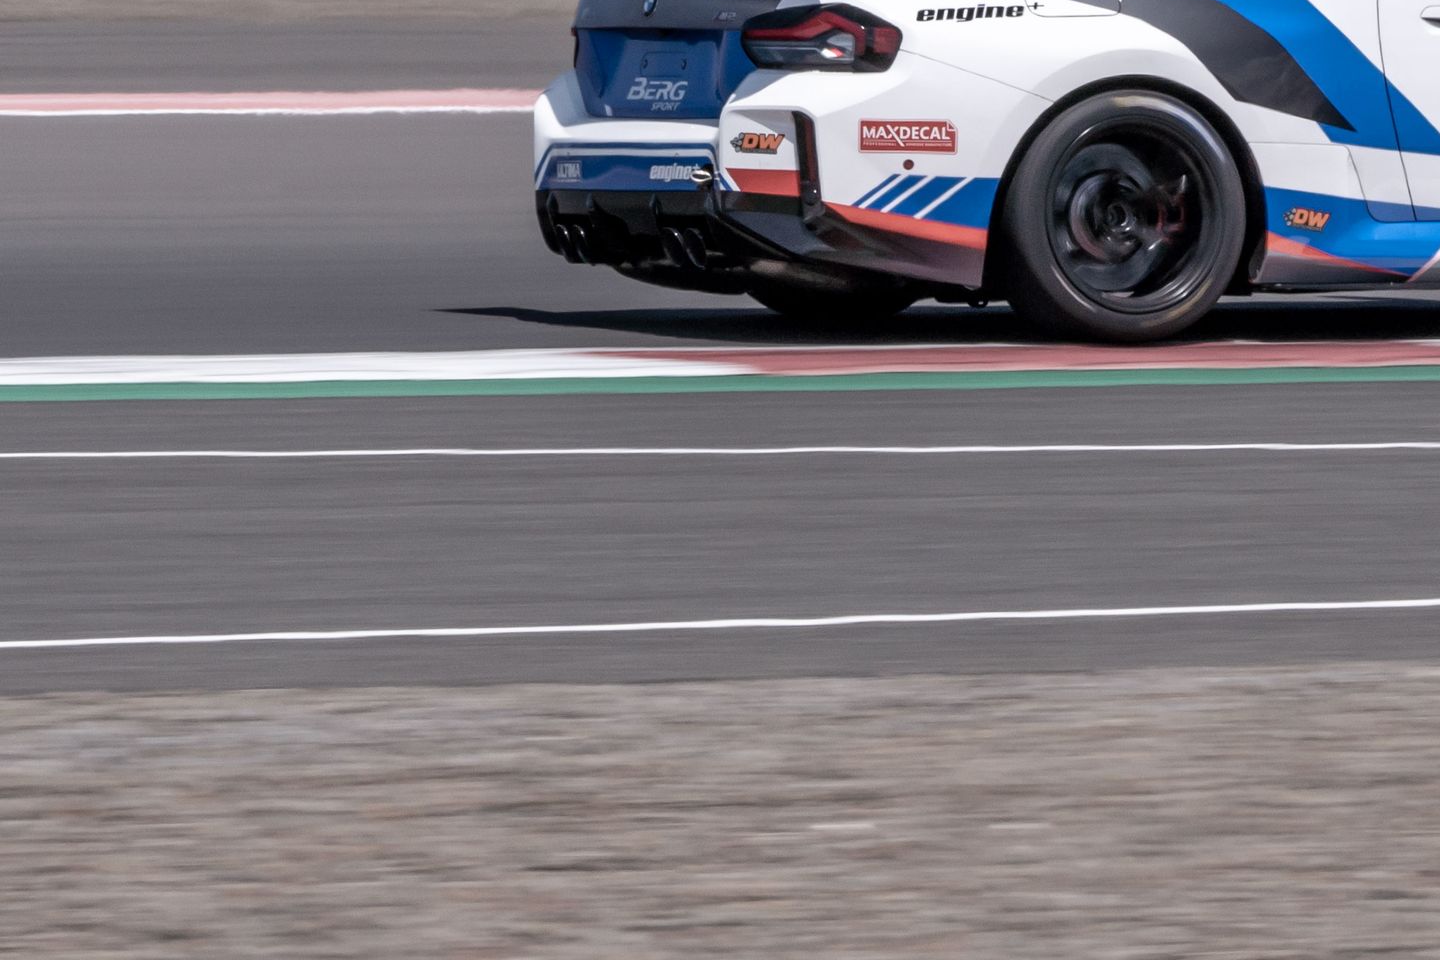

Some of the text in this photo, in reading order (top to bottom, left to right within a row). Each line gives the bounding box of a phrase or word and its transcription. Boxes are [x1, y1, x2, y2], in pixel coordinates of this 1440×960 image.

[742, 133, 785, 150] DW
[862, 125, 951, 147] MAXDECAL
[1293, 208, 1330, 228] DW
